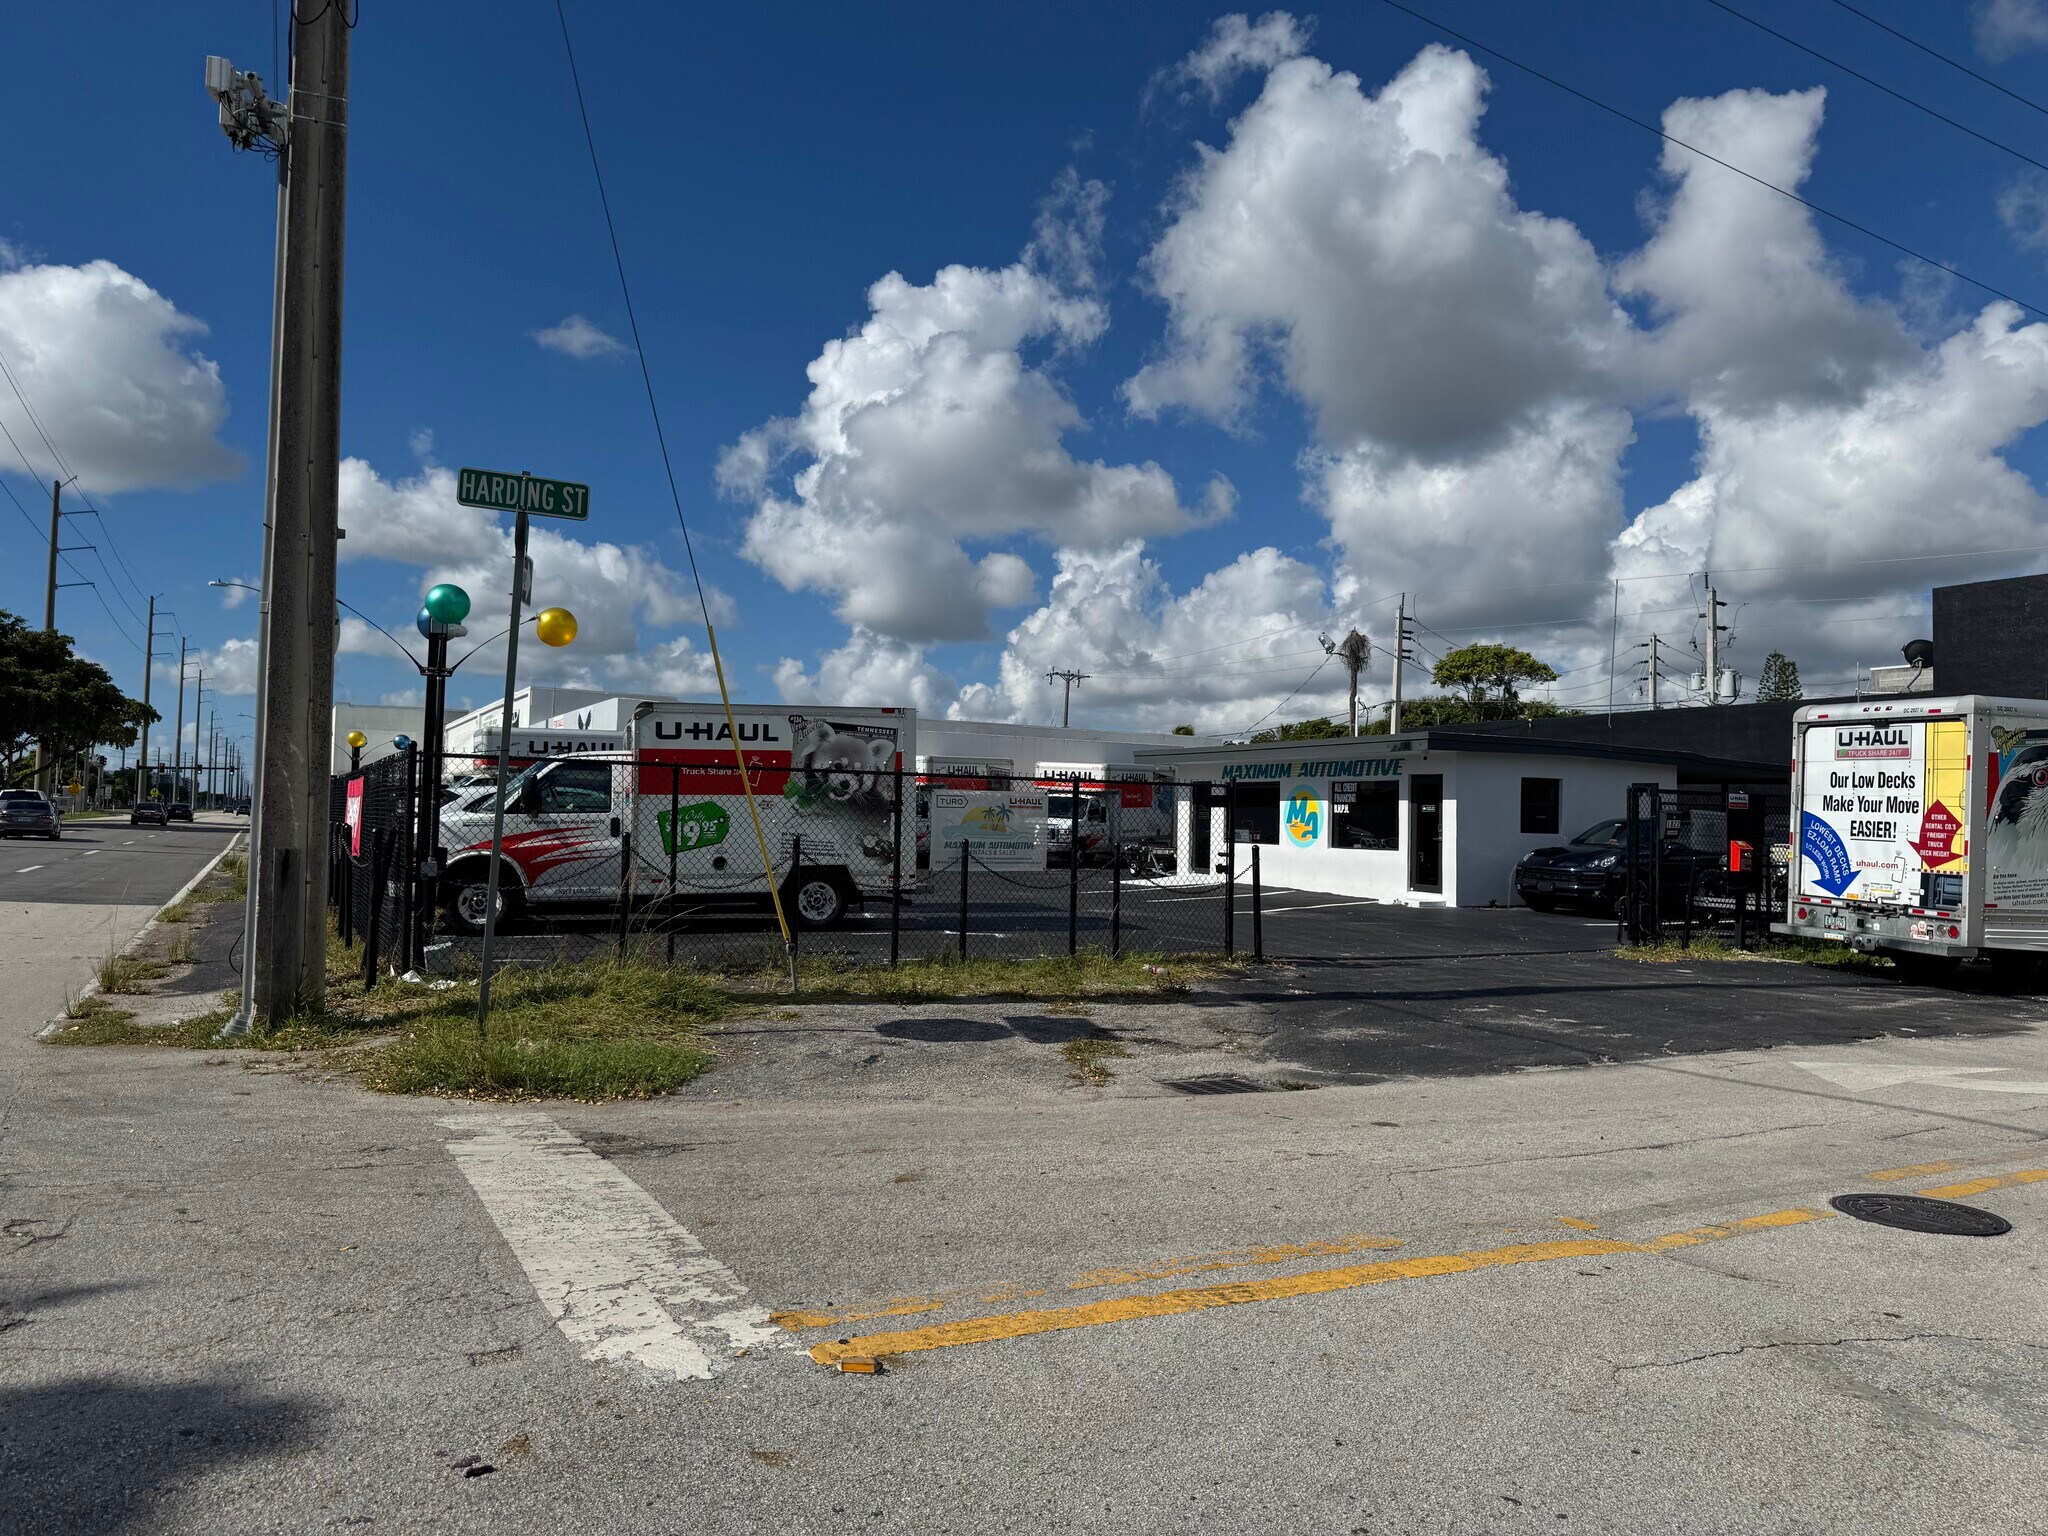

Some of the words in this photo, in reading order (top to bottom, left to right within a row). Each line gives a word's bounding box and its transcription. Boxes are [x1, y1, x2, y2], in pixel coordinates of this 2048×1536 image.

[461, 473, 554, 510] HARDING
[561, 486, 586, 514] ST
[656, 721, 779, 742] U-HAUL
[857, 726, 894, 735] TENNESSEE
[1838, 730, 1908, 746] U-HAUL
[682, 766, 705, 775] Truck
[708, 768, 731, 776] Share
[948, 765, 980, 775] U-HAUL
[1222, 762, 1292, 780] MAXIMUM
[1298, 758, 1406, 777] AUTOMOTIVE
[1122, 772, 1148, 782] U-HAUL
[1830, 772, 1849, 788] Our
[1852, 772, 1874, 788] Low
[1878, 772, 1915, 788] Decks
[1334, 783, 1342, 792] ALL
[1342, 783, 1357, 792] CREDIT
[1009, 797, 1042, 805] U-HAUL
[1334, 794, 1356, 802] FINANCING
[1823, 795, 1853, 812] Make
[1857, 796, 1883, 813] Your
[1886, 796, 1919, 813] Move
[702, 820, 718, 832] 95
[1850, 820, 1897, 838] EASIER!
[944, 841, 986, 849] MAXMUM
[988, 841, 1035, 850] AUTOMOTIVE
[1810, 820, 1837, 844] LOWEST
[1834, 845, 1849, 876] DECKS
[1807, 830, 1832, 858] EZ-LOAD
[1830, 858, 1841, 884] RAMP
[1812, 848, 1824, 862] LESS
[1821, 860, 1830, 880] WORK
[1856, 860, 1898, 869] uhaul.com
